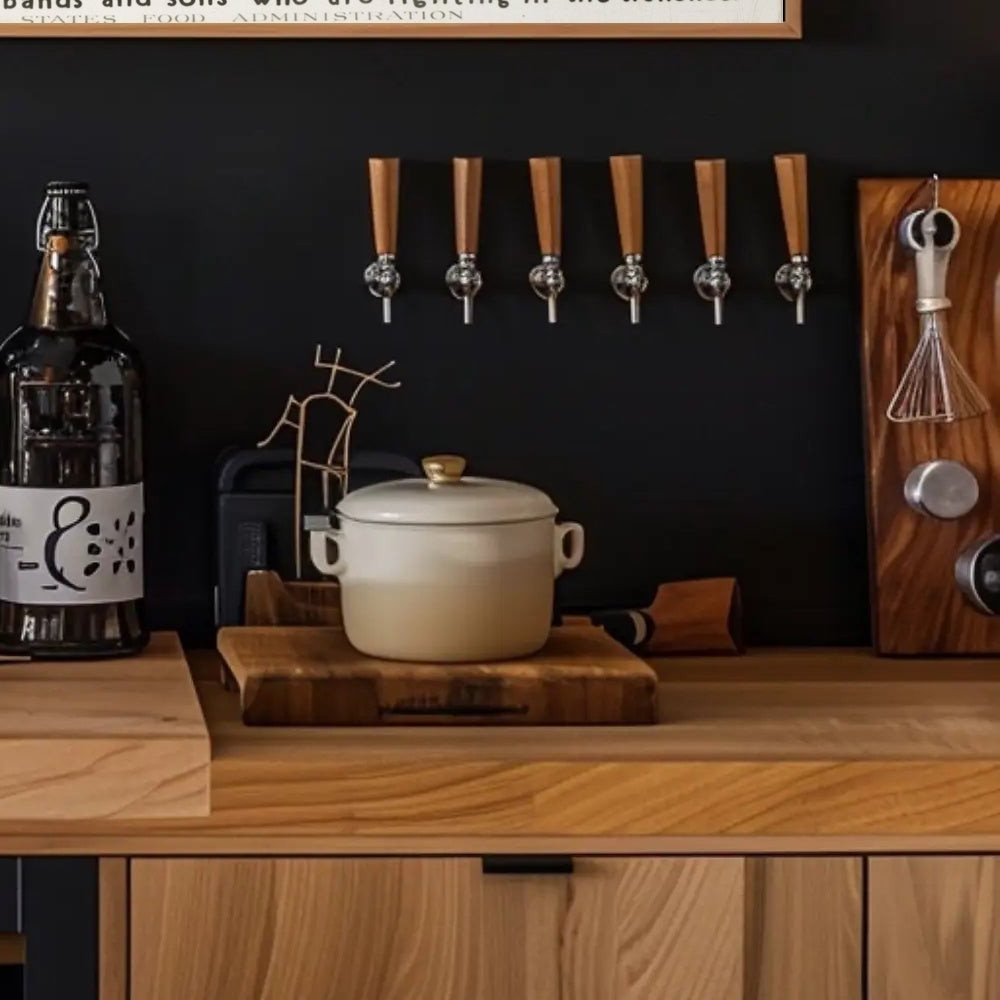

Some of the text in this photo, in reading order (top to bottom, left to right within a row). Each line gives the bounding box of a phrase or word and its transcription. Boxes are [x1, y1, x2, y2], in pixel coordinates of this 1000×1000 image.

[21, 14, 117, 24] STATES
[143, 13, 206, 24] FOOD
[231, 9, 464, 23] ADMINISTRATION
